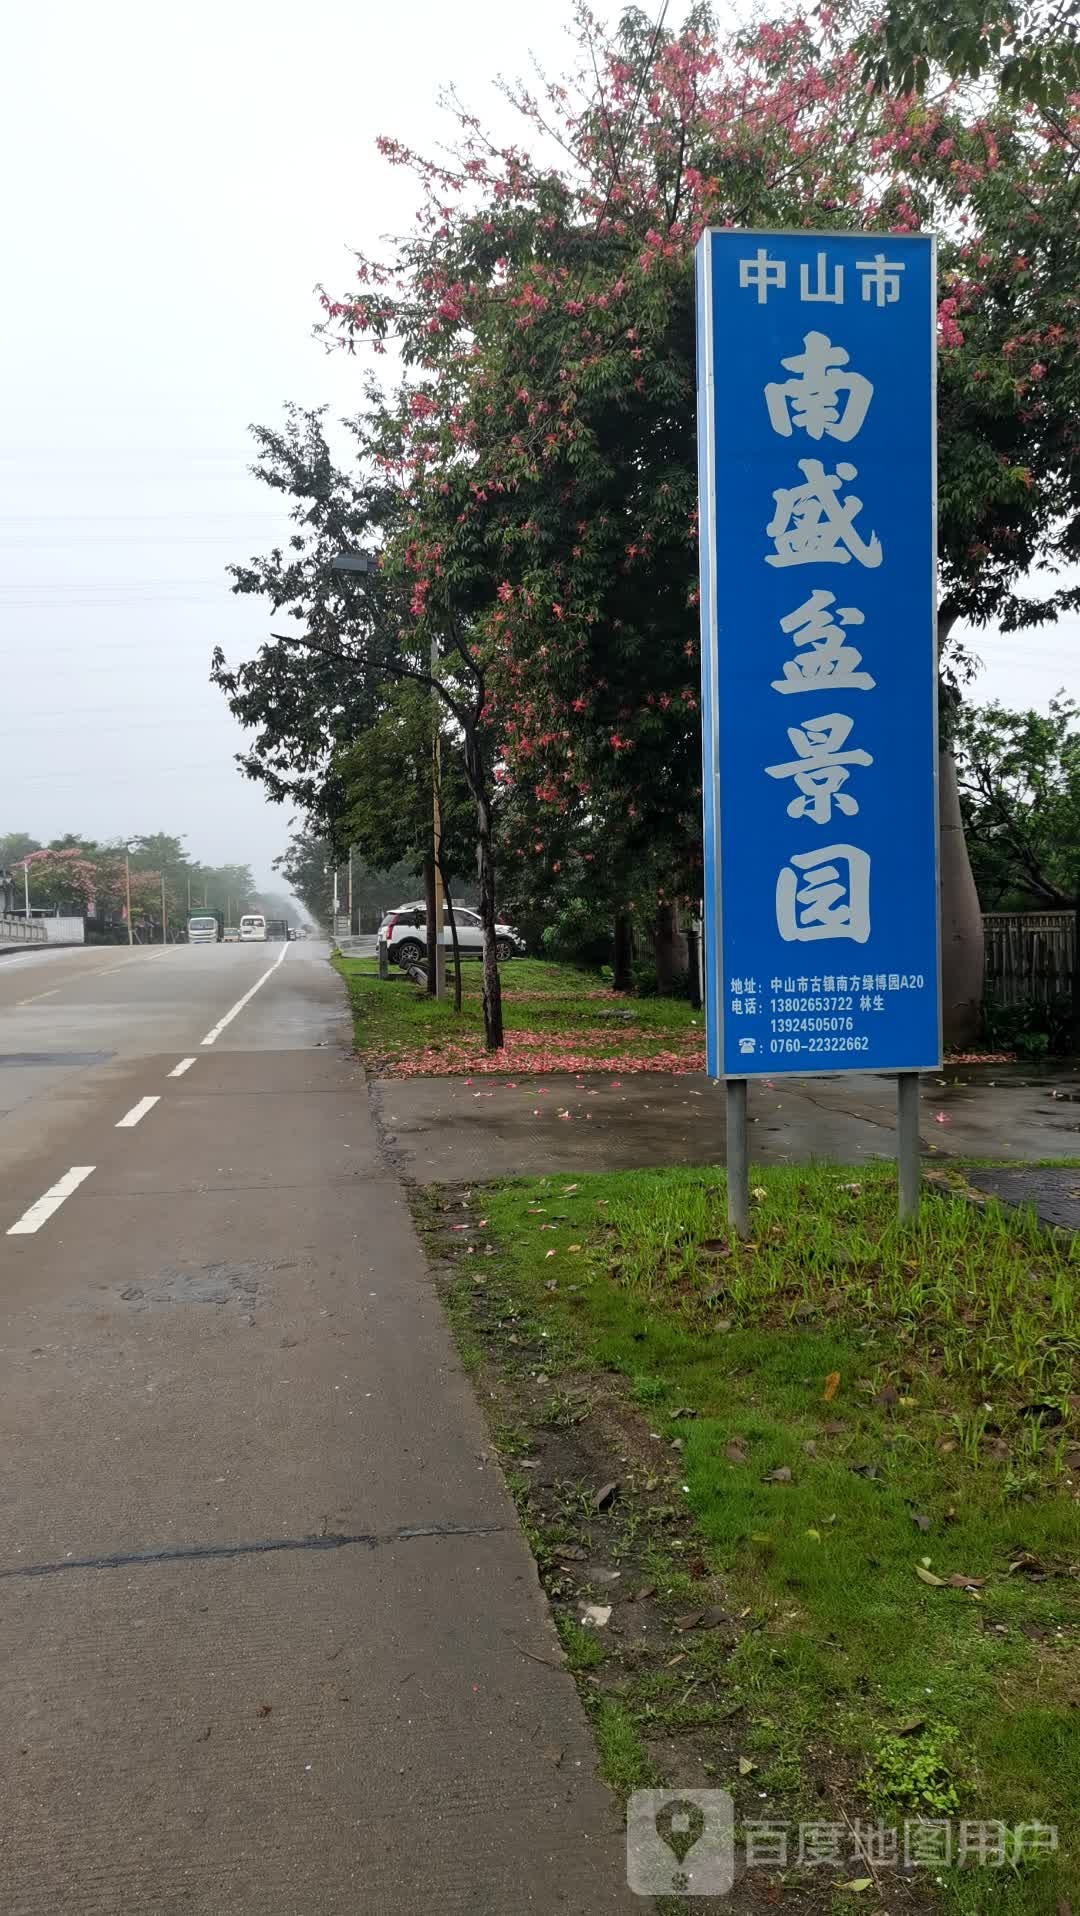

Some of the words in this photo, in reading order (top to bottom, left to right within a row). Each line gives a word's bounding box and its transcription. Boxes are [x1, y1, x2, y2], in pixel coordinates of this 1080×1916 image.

[738, 247, 906, 307] 中山市
[764, 331, 883, 943] 南盛盆景园
[770, 1016, 854, 1033] 13924505076
